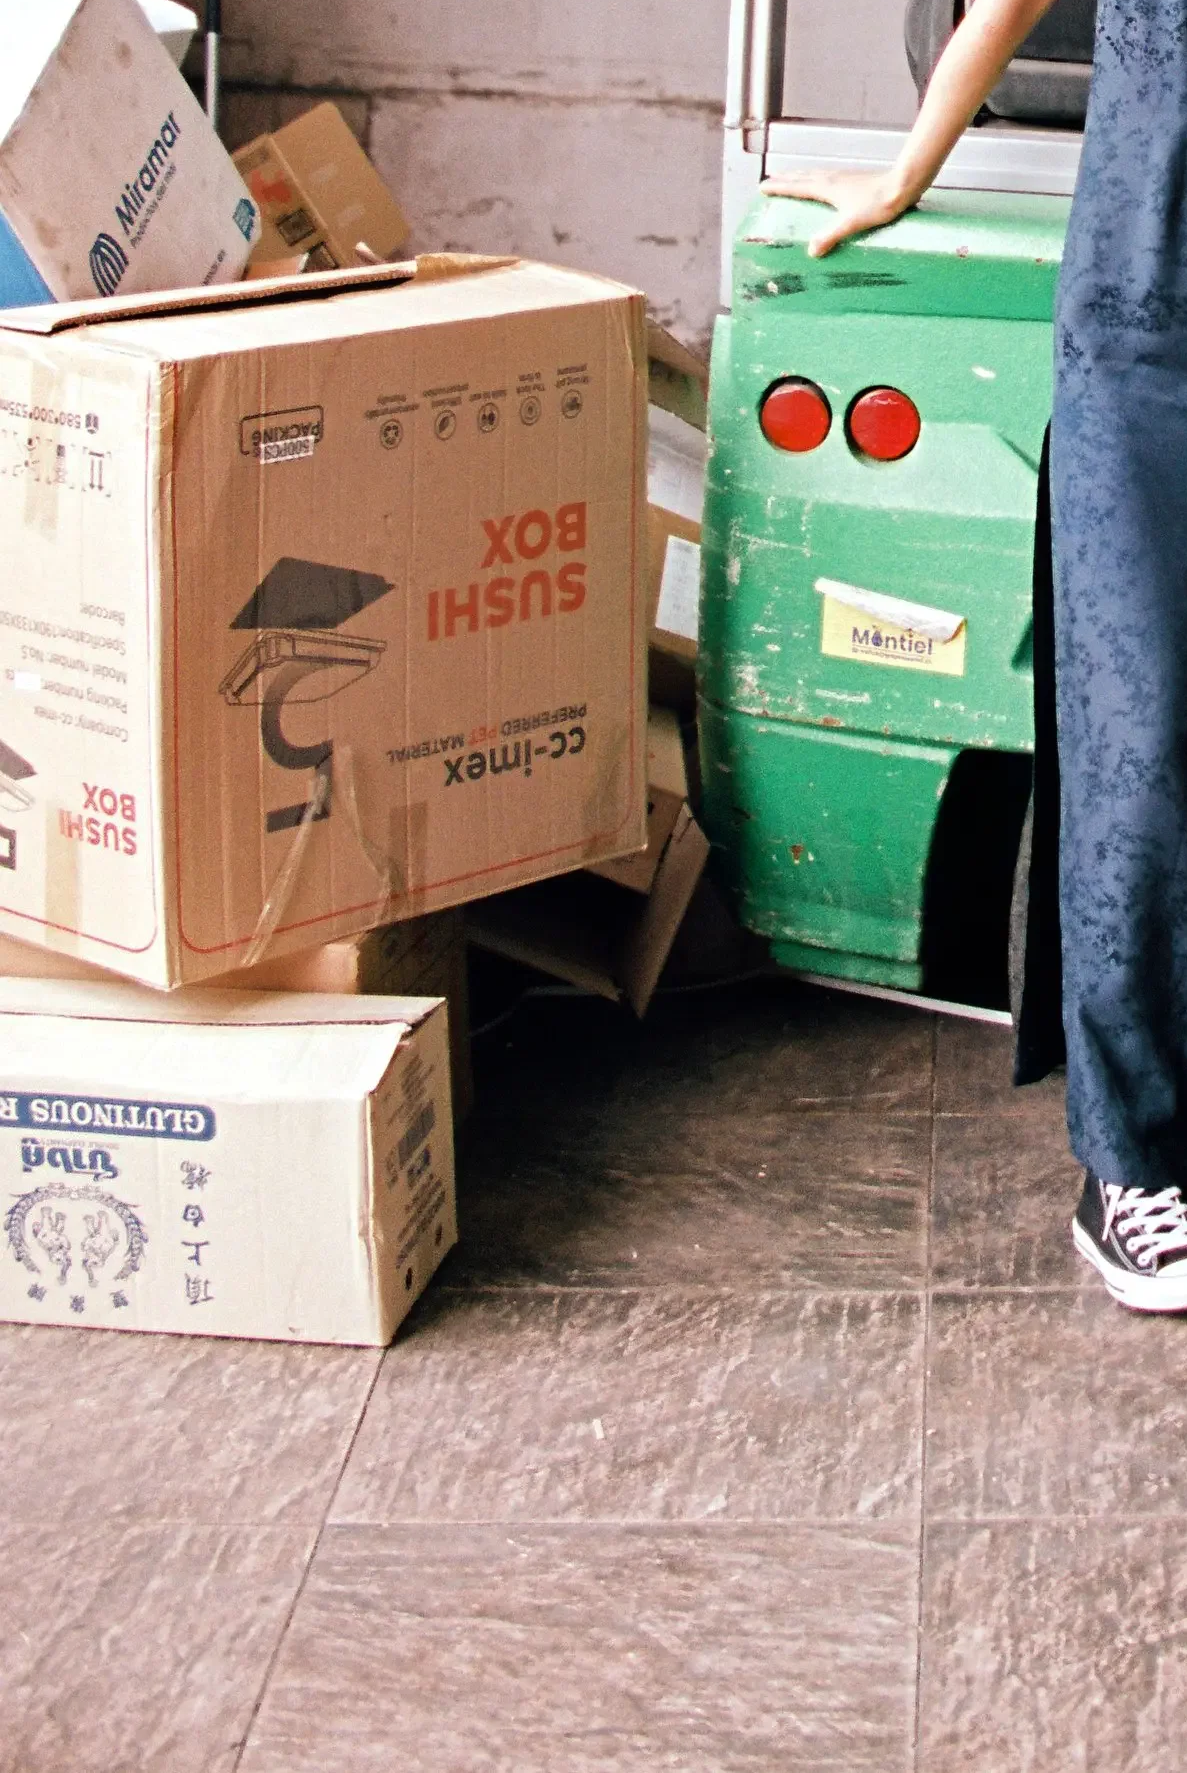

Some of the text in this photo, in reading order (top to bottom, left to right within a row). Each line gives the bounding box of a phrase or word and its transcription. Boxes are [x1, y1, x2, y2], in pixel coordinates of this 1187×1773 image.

[115, 111, 182, 234] Miramar
[252, 421, 322, 447] PACKING
[481, 502, 587, 568] BOX
[426, 563, 587, 642] SUSHI
[851, 625, 933, 656] Montiel
[387, 704, 587, 763] PREFERRED PET MATERIAL
[444, 725, 587, 787] cc-imex
[82, 782, 136, 822] BOX
[58, 808, 137, 856] SUSHI
[30, 1098, 206, 1134] GLUTINOUS
